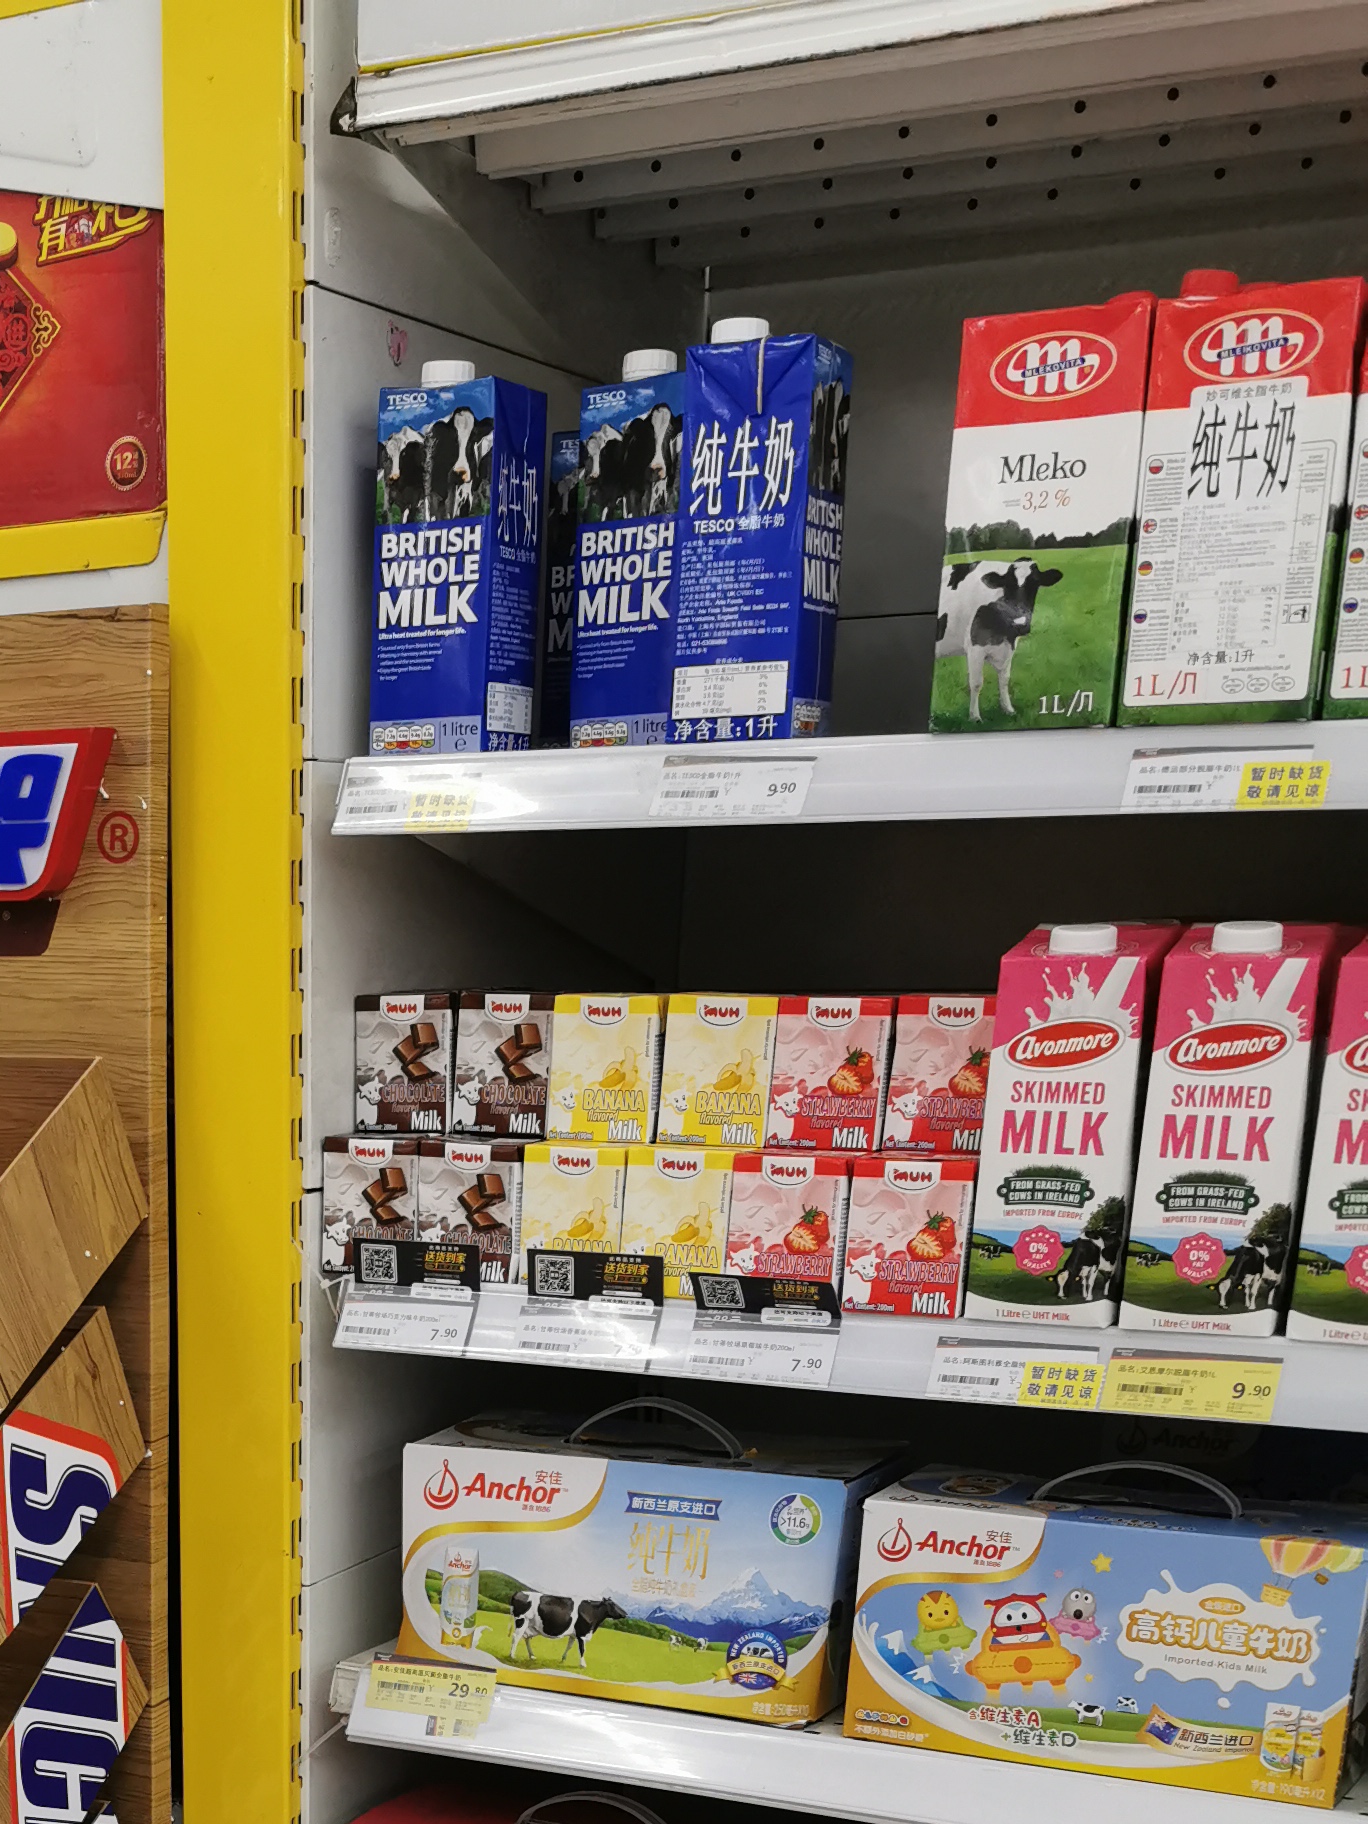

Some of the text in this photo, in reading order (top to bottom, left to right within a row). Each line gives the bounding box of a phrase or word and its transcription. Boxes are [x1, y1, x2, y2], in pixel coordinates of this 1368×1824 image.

[1188, 399, 1297, 501] 纯牛奶
[689, 418, 796, 517] 纯牛奶
[998, 451, 1087, 485] Mleko
[1022, 491, 1050, 513] 3,2
[694, 513, 785, 534] TESCO 全脂牛奶
[381, 525, 482, 559] BRITISH
[581, 522, 675, 558] BRITISH
[804, 526, 843, 562] WHOLE
[381, 554, 480, 588] WHOLE
[580, 551, 672, 585] WHOLE
[803, 556, 840, 603] MILK
[378, 584, 479, 631] MILK
[577, 580, 671, 628] MILK
[451, 722, 478, 736] litre
[1251, 766, 1325, 783] 暂时缺货
[1246, 783, 1321, 800] 敬请见谅
[483, 1085, 546, 1105] CHOCOLATE
[583, 1089, 645, 1112] BANANA
[695, 1091, 761, 1115] BANANA
[1011, 1081, 1105, 1105] SKIMMED
[1171, 1084, 1272, 1109] SKIMMED
[801, 1096, 876, 1118] STRAWBERRY
[1001, 1110, 1109, 1157] MILK
[1160, 1114, 1274, 1162] MILK
[1010, 1179, 1081, 1192] FROM GRASS-FED
[1009, 1192, 1030, 1204] COWS
[1043, 1193, 1081, 1205] IRELAND
[1030, 1242, 1049, 1255] 0%
[878, 1259, 958, 1283] STRAWBERRY
[911, 1292, 950, 1316] Milk
[1030, 1365, 1098, 1382] 暂时缺货
[1027, 1382, 1094, 1401] 敬请见谅
[1231, 1381, 1272, 1400] 9.90
[462, 1471, 560, 1506] Anchor
[535, 1468, 563, 1485] 安佳
[632, 1496, 716, 1516] 新西兰原支进口
[914, 1530, 1011, 1563] Anchor
[986, 1529, 1013, 1544] 安佳
[627, 1521, 711, 1581] 纯牛奶
[1131, 1611, 1308, 1661] 高钙儿童牛奶
[1245, 1664, 1268, 1675] Milk
[1178, 1727, 1254, 1747] 新西兰进口
